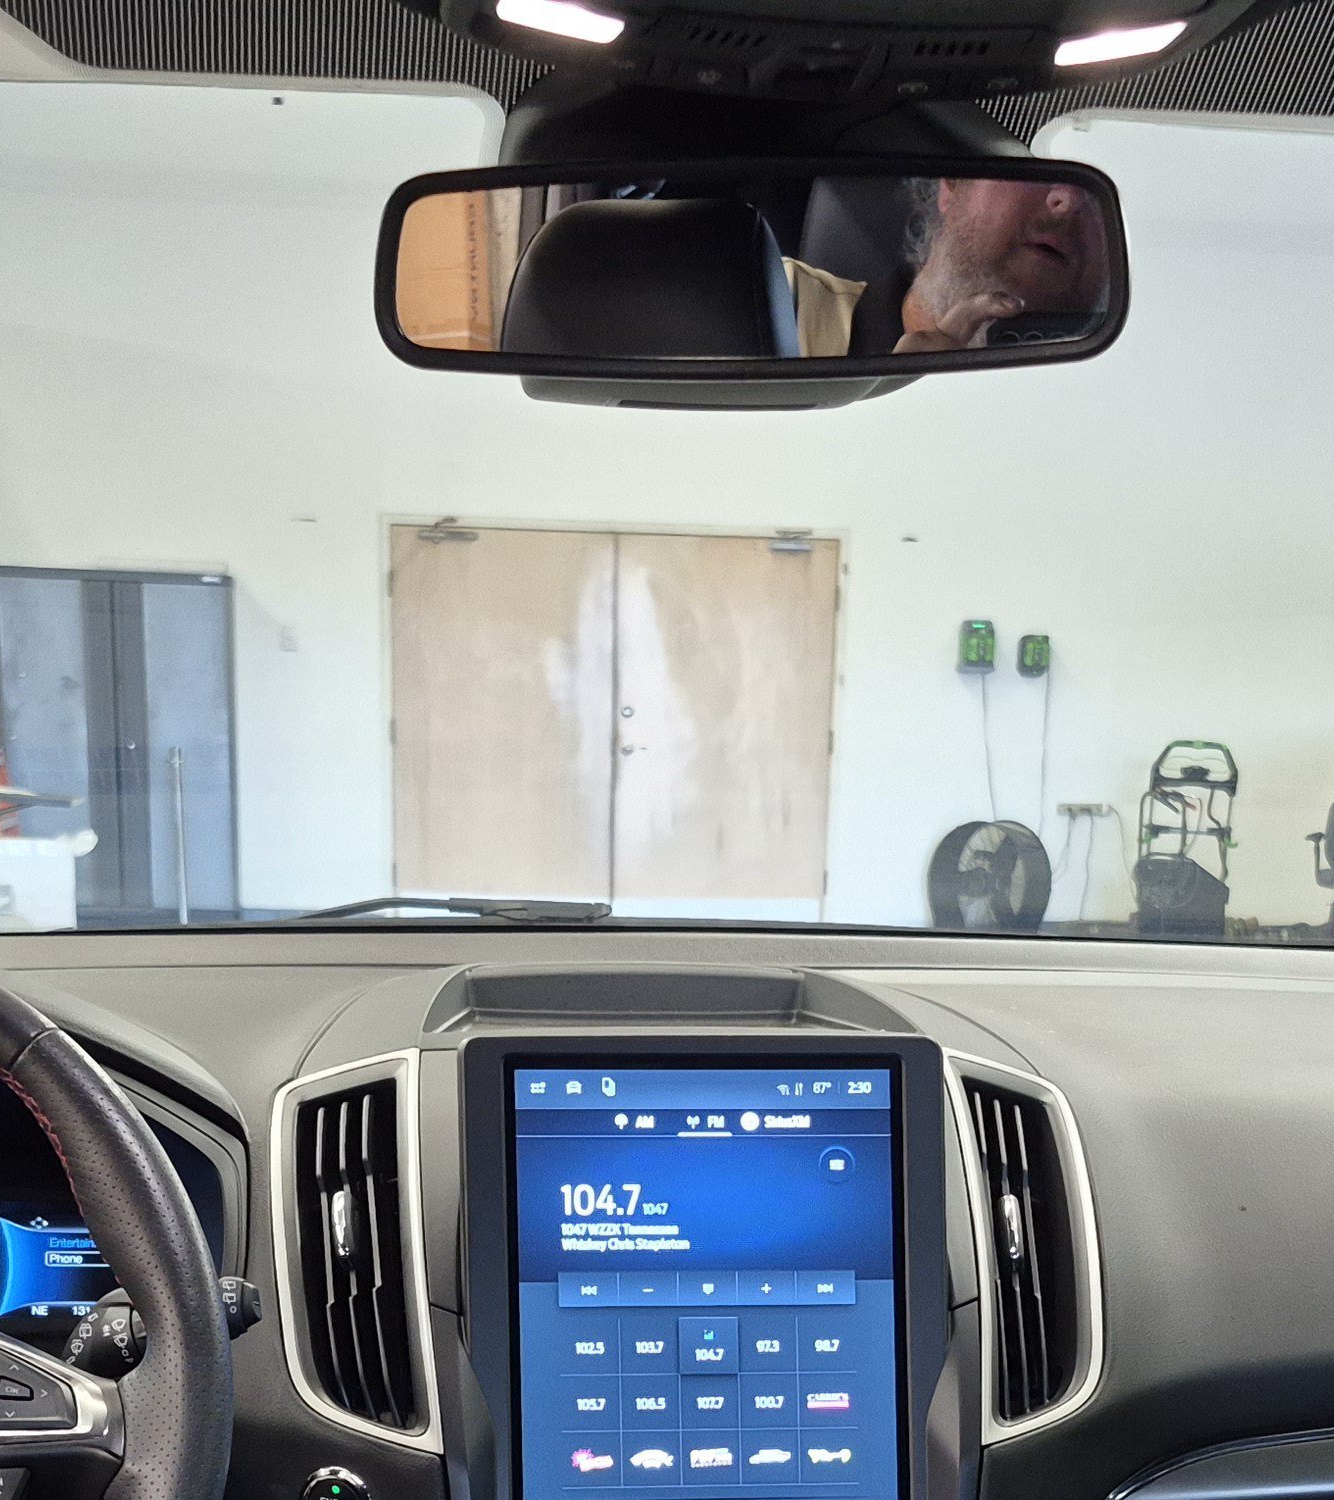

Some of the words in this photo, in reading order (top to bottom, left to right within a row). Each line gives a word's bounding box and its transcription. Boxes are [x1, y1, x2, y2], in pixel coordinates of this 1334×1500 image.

[635, 1115, 655, 1128] AM
[707, 1115, 725, 1128] FM
[560, 1183, 642, 1217] 104.7
[49, 1254, 83, 1264] Phone
[31, 1306, 48, 1315] NE
[575, 1341, 605, 1355] 102.5
[5, 1385, 20, 1394] OK
[754, 1396, 784, 1409] 100.7
